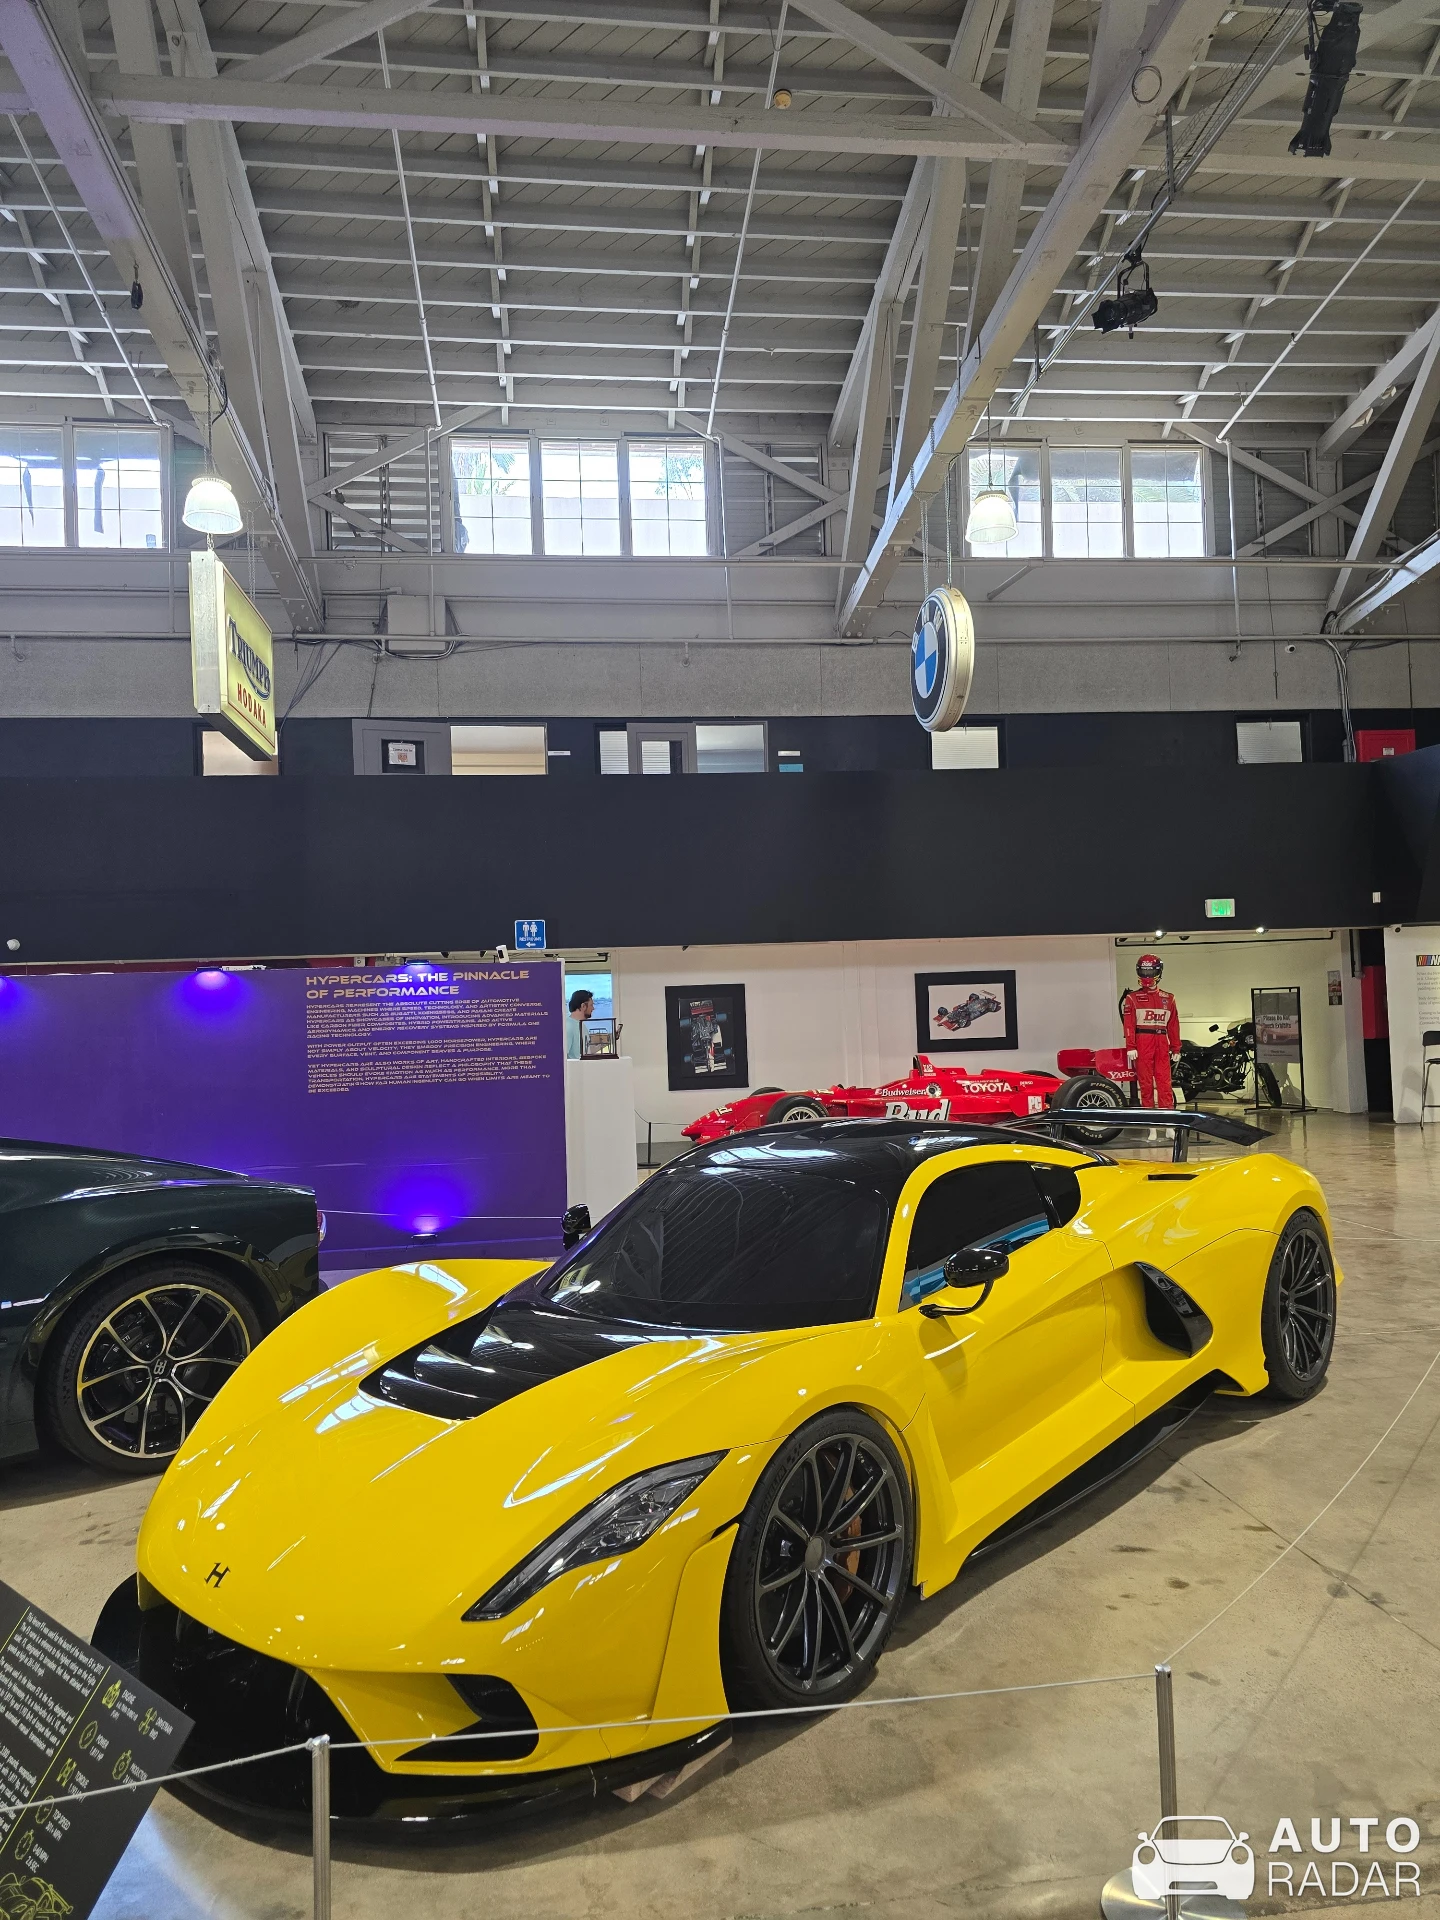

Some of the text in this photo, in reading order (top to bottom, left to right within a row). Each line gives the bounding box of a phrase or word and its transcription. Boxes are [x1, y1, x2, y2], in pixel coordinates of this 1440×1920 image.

[237, 682, 266, 728] HODAKA
[306, 970, 530, 985] HYPERCARS: THE PINNACLE
[306, 985, 460, 999] OF PERFORMANCE
[1143, 1010, 1167, 1022] Bud
[881, 1088, 926, 1097] Budweiser
[962, 1082, 1012, 1093] TOYOTA
[885, 1099, 950, 1121] Bud
[755, 1465, 787, 1532] MICHELIN
[204, 1562, 231, 1588] H
[53, 1809, 70, 1830] TOP SPEED
[53, 1829, 62, 1841] MPH
[39, 1850, 48, 1863] MPH
[30, 1861, 39, 1873] SEC
